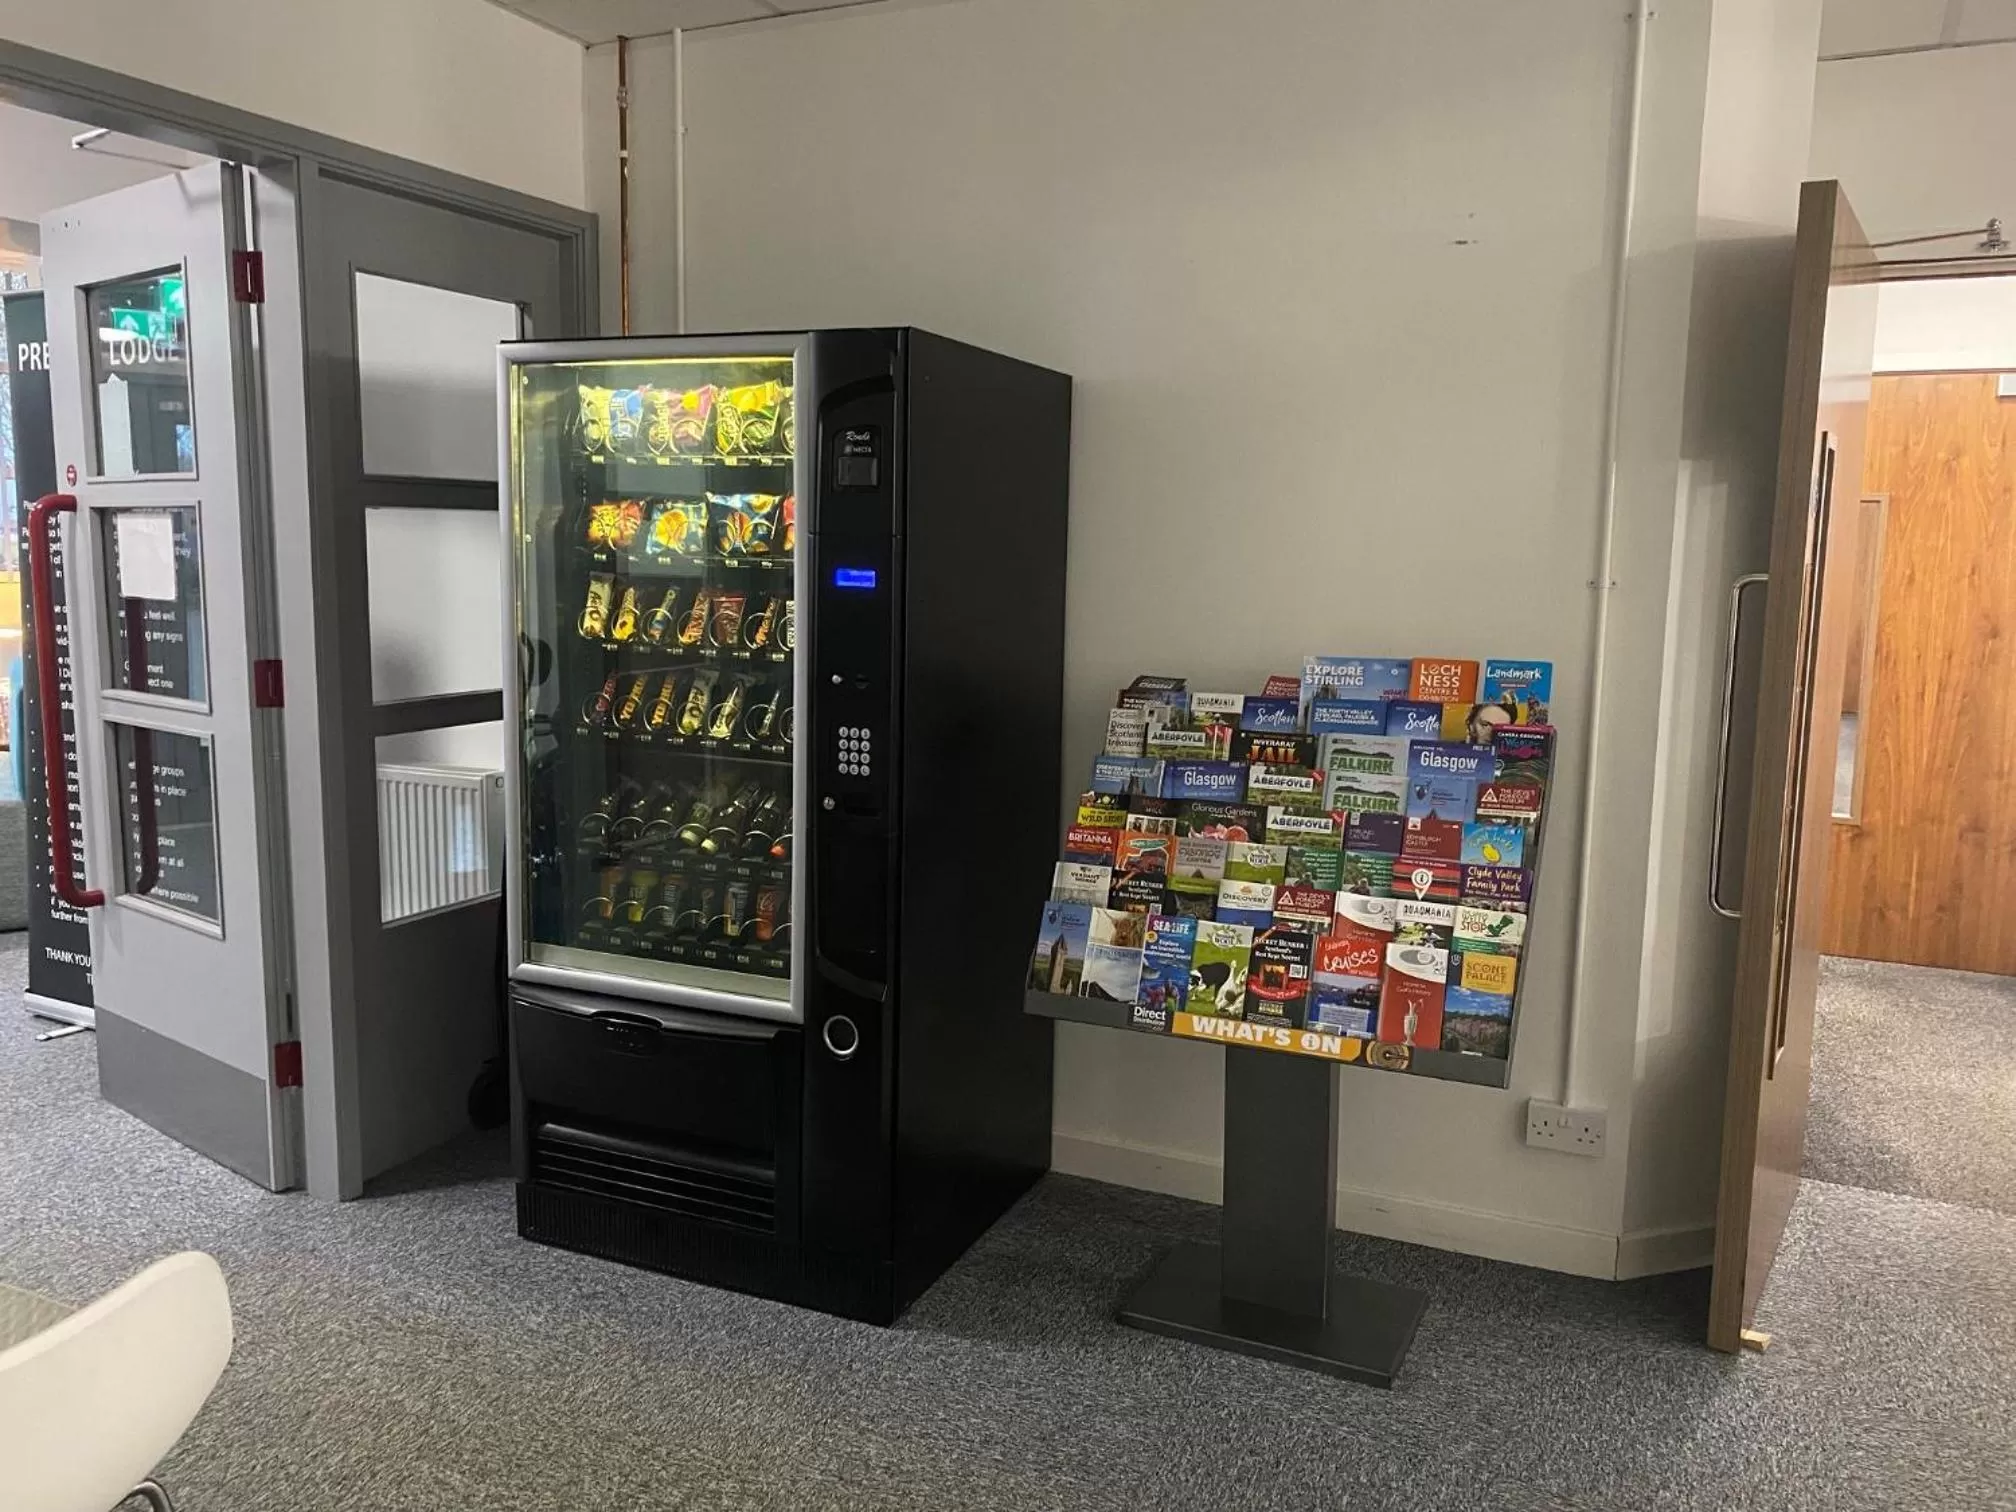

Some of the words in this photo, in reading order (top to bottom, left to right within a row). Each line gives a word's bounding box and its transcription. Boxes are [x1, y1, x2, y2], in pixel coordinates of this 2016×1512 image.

[109, 336, 182, 366] LODGE
[1306, 664, 1364, 676] EXPLORE
[1421, 663, 1462, 676] LOCH
[1487, 665, 1542, 681] Landmark
[1305, 675, 1364, 686] STIRLING
[1419, 675, 1461, 688] NESS
[1151, 731, 1204, 743] ABERFOYLE
[1250, 746, 1297, 763] JAIL
[1420, 751, 1478, 772] Glasgow
[1329, 756, 1394, 773] FALKIRK
[1184, 771, 1236, 789] Glasgow
[1253, 774, 1312, 788] ABERFOYLE
[1333, 794, 1400, 812] FALKIRK
[1271, 817, 1330, 830] ABERFOYLE
[1068, 832, 1113, 844] BRITANNIA
[1468, 866, 1493, 880] Clyde
[1495, 867, 1523, 883] Valley
[1466, 877, 1498, 894] Family
[1500, 880, 1521, 892] Park
[1222, 893, 1269, 904] DISCOVERY
[1153, 919, 1169, 932] SEA
[1171, 922, 1190, 934] LIFE
[1460, 921, 1488, 933] STOP
[45, 947, 74, 964] THANK
[73, 953, 91, 968] YOU
[1466, 962, 1508, 974] SCONE
[1133, 1006, 1167, 1021] Direct
[1191, 1015, 1291, 1046] WHAT'S
[1301, 1032, 1342, 1055] ON
